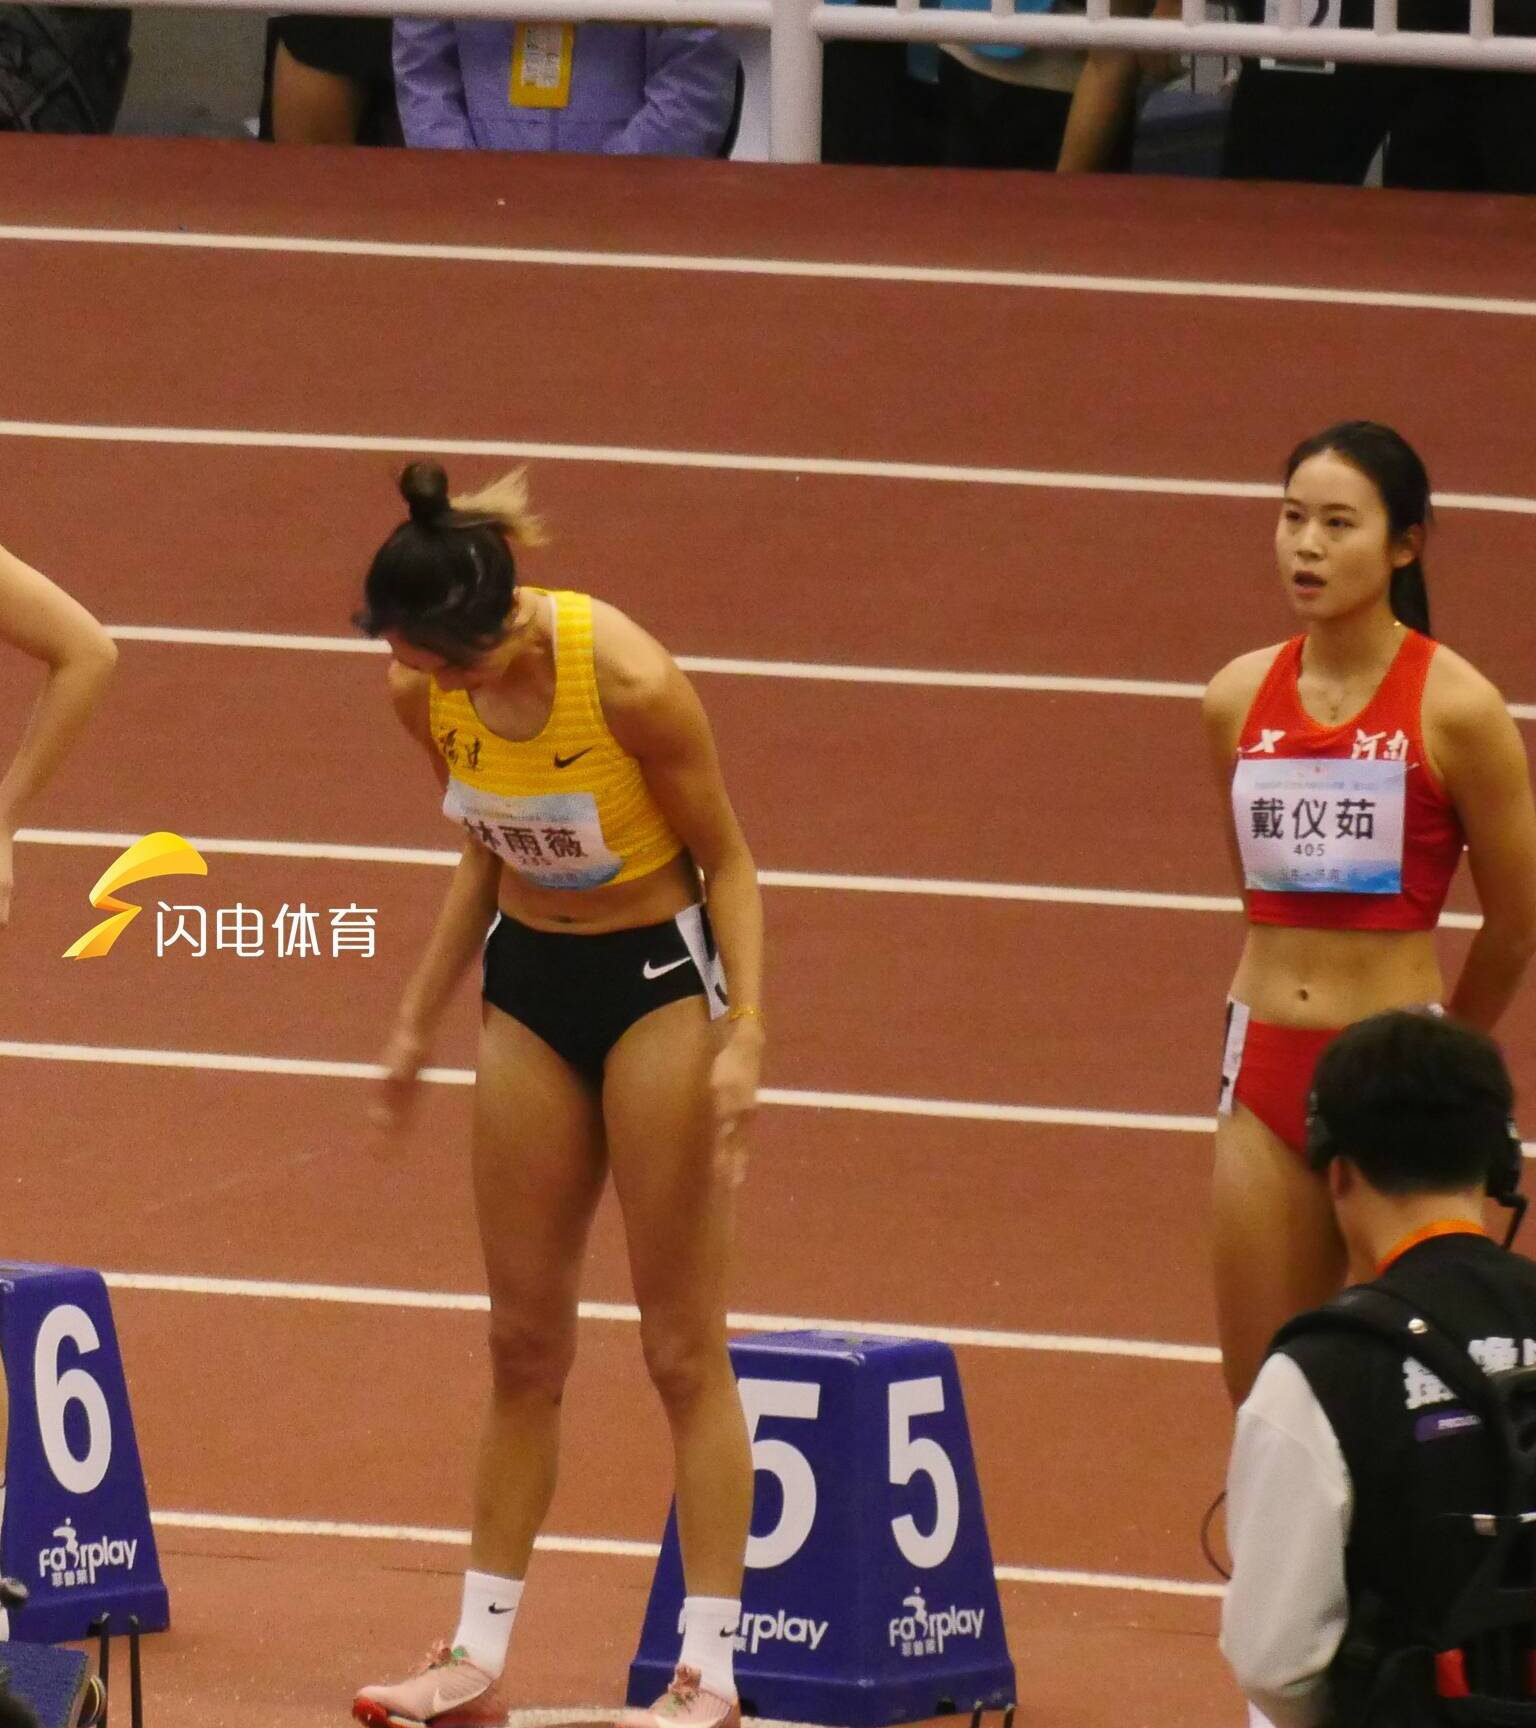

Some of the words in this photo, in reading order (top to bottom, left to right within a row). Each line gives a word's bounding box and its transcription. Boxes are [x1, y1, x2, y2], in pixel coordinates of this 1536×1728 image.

[1250, 798, 1376, 840] 戴仪茹
[1293, 843, 1325, 857] 405
[34, 1304, 112, 1494] 6
[736, 1377, 821, 1569] 5
[888, 1376, 960, 1569] 5
